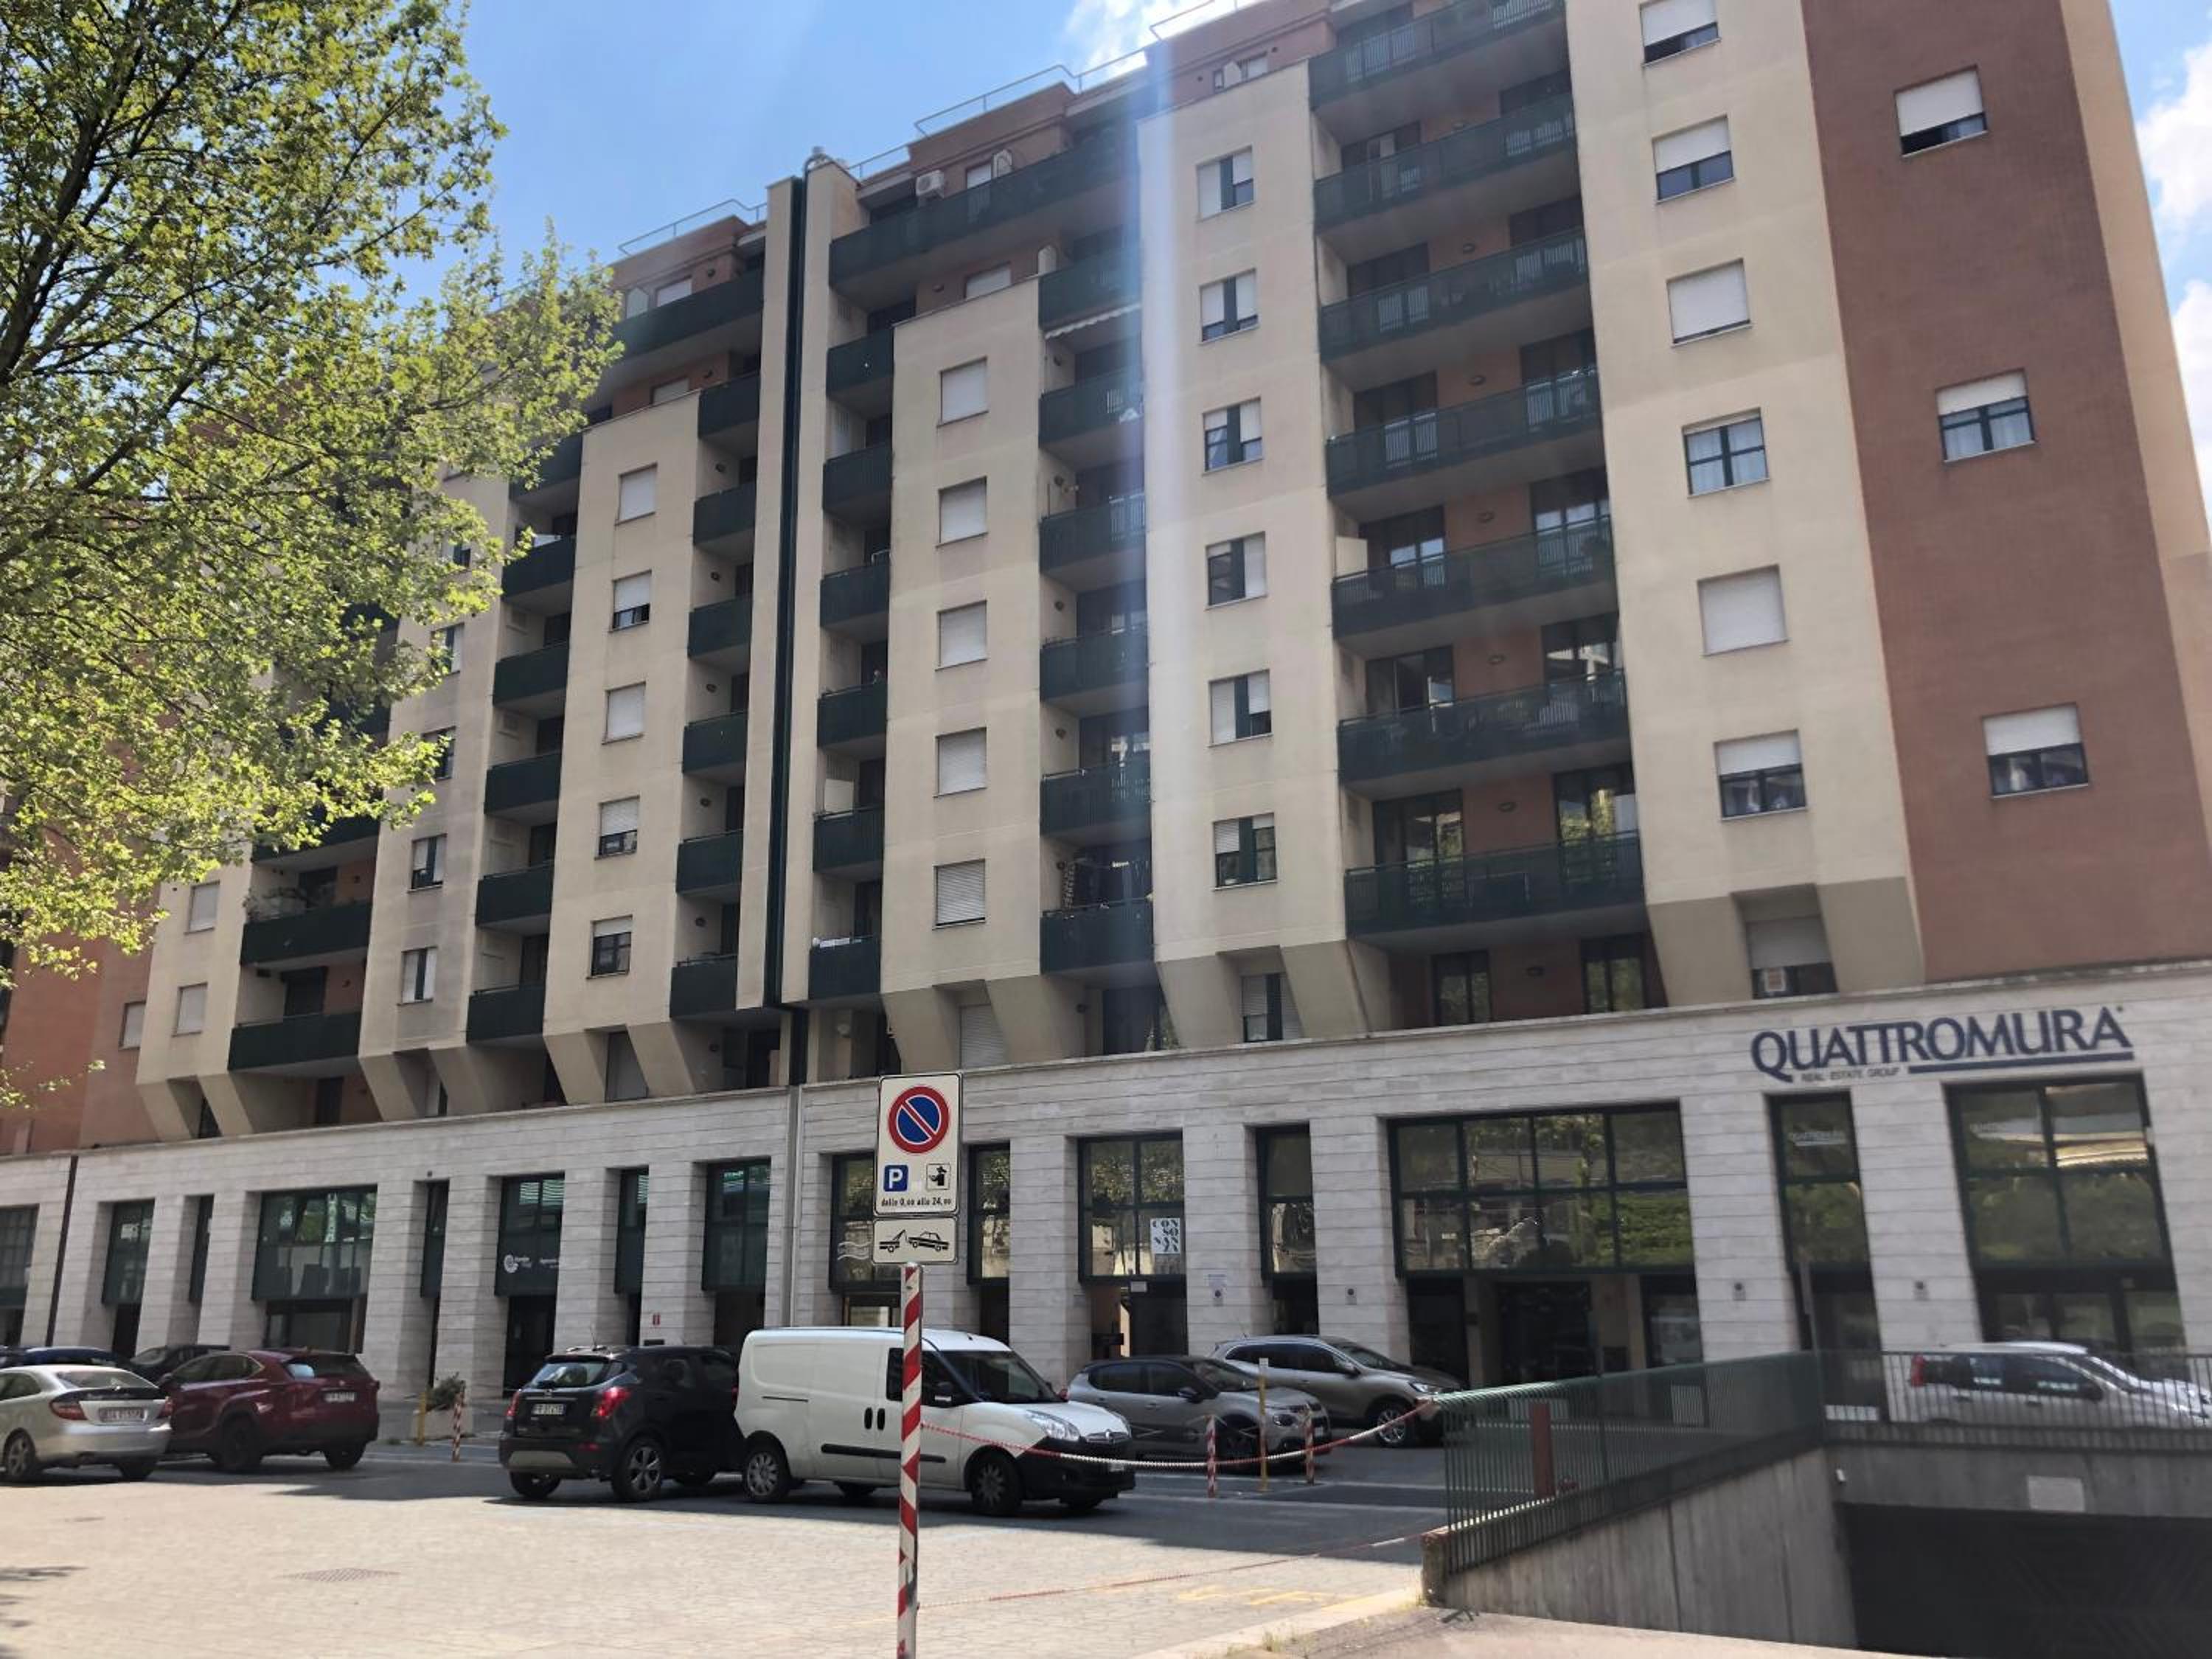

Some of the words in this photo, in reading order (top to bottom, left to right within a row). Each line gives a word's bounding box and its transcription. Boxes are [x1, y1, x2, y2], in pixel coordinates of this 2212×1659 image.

[1751, 1006, 2132, 1082] QUATTROMURA
[1801, 1073, 1826, 1082] REAL
[1829, 1070, 1863, 1079] ESTATE
[1867, 1067, 1900, 1077] GROUP
[888, 1169, 903, 1189] P
